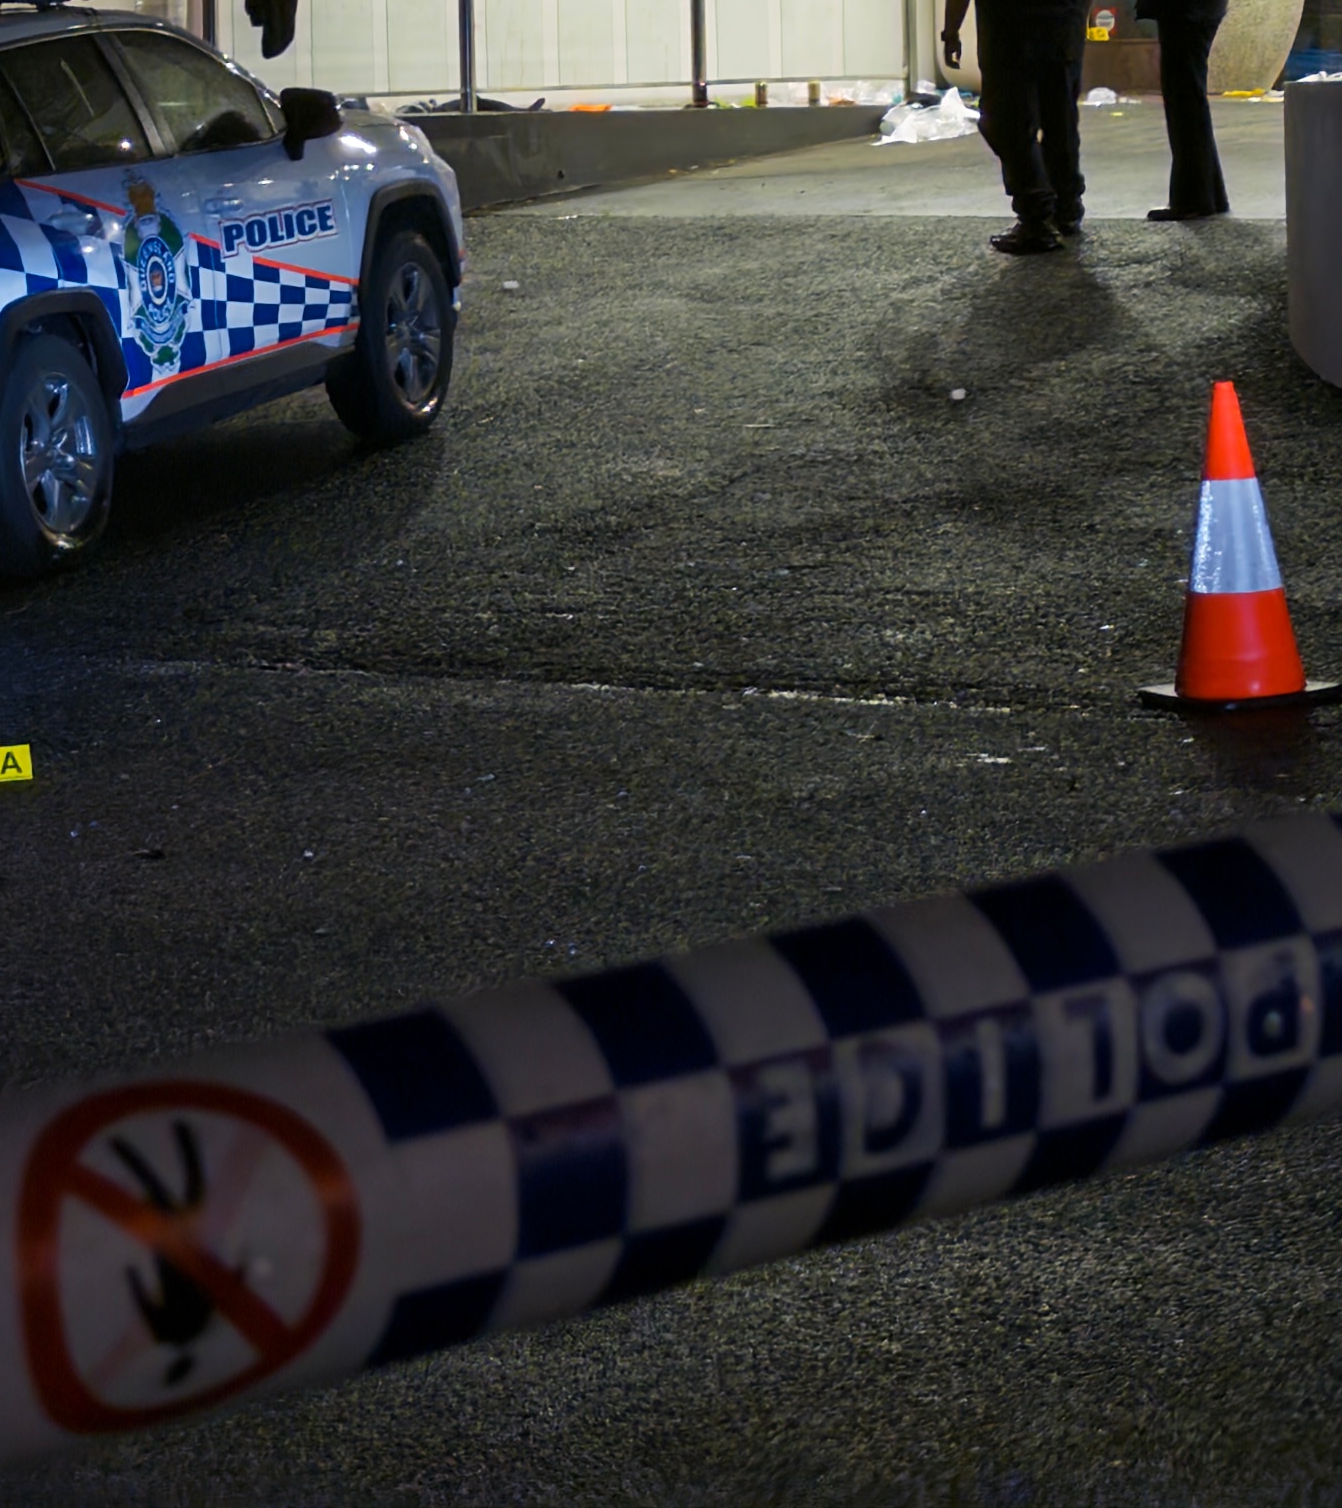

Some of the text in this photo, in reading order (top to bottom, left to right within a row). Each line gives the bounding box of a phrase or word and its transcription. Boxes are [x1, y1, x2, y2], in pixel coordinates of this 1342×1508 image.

[222, 204, 336, 253] POLICE
[0, 750, 23, 776] A
[759, 949, 1304, 1183] POLICE
